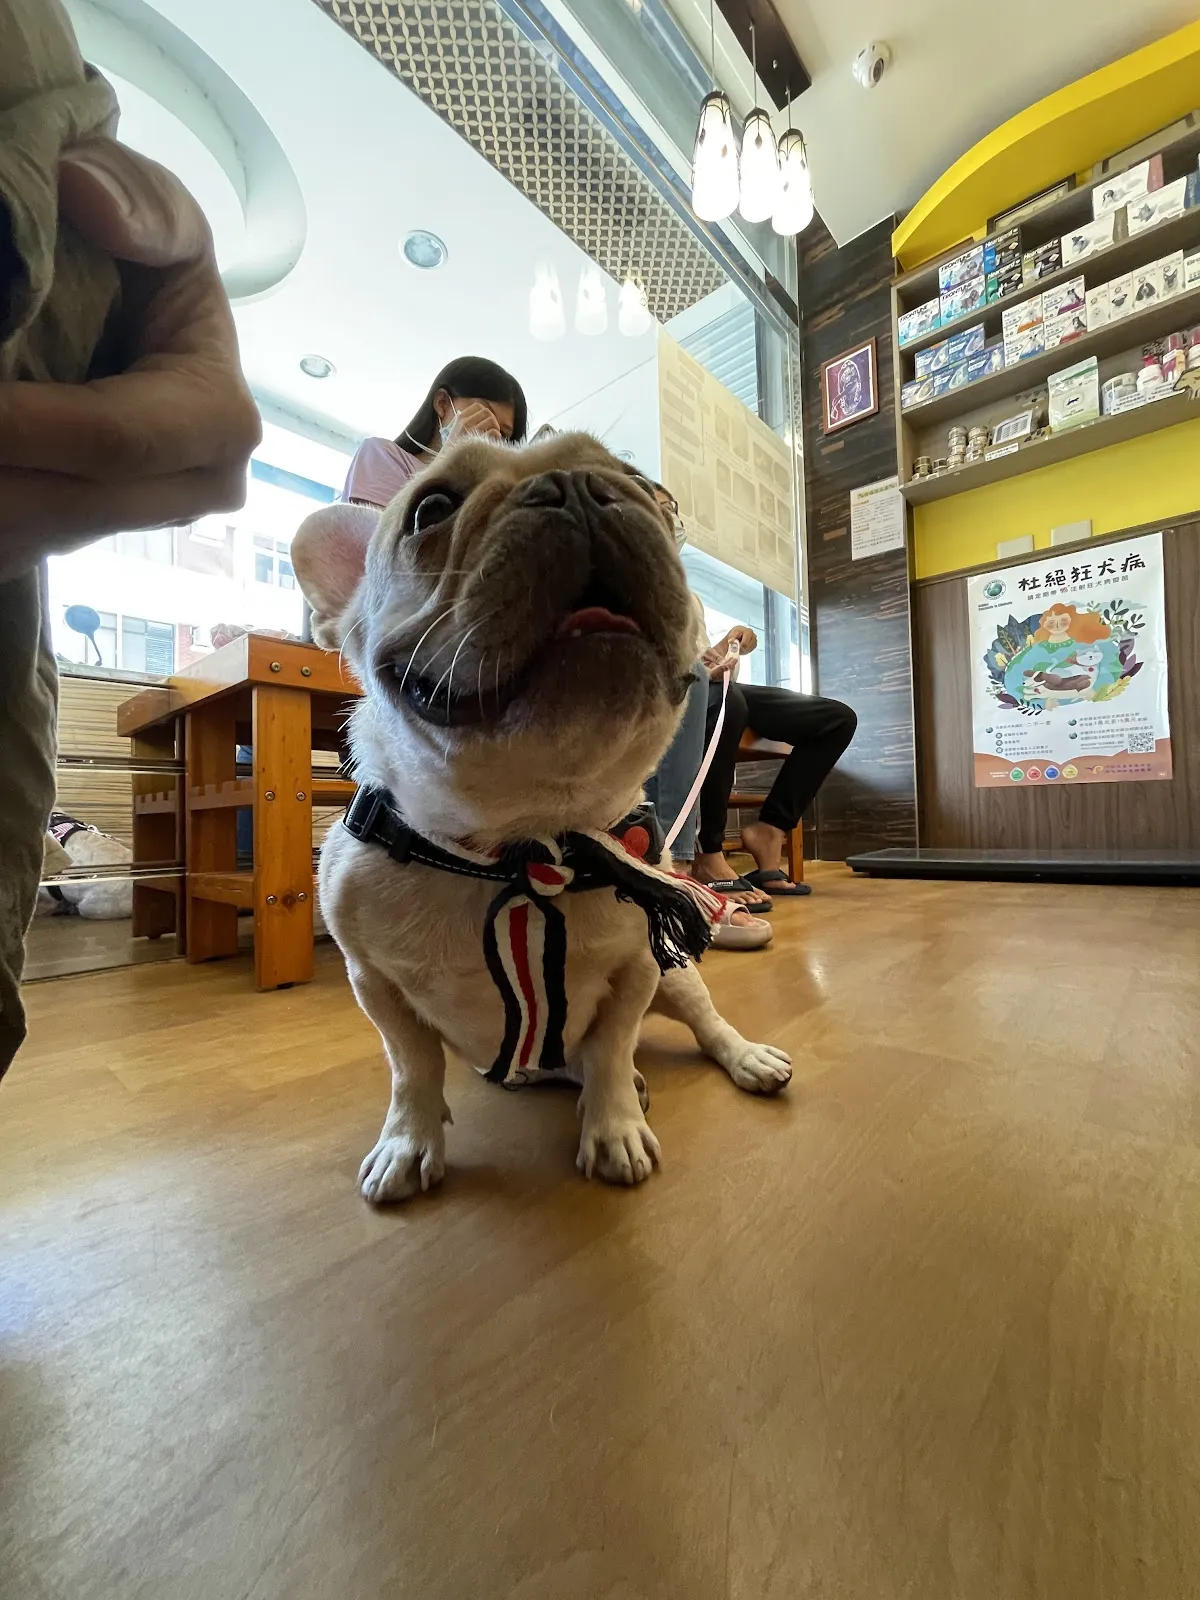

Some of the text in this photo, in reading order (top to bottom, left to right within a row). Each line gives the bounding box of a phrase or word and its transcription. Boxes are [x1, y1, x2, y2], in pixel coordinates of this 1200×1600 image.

[1018, 553, 1146, 592] 杜絕狂犬病
